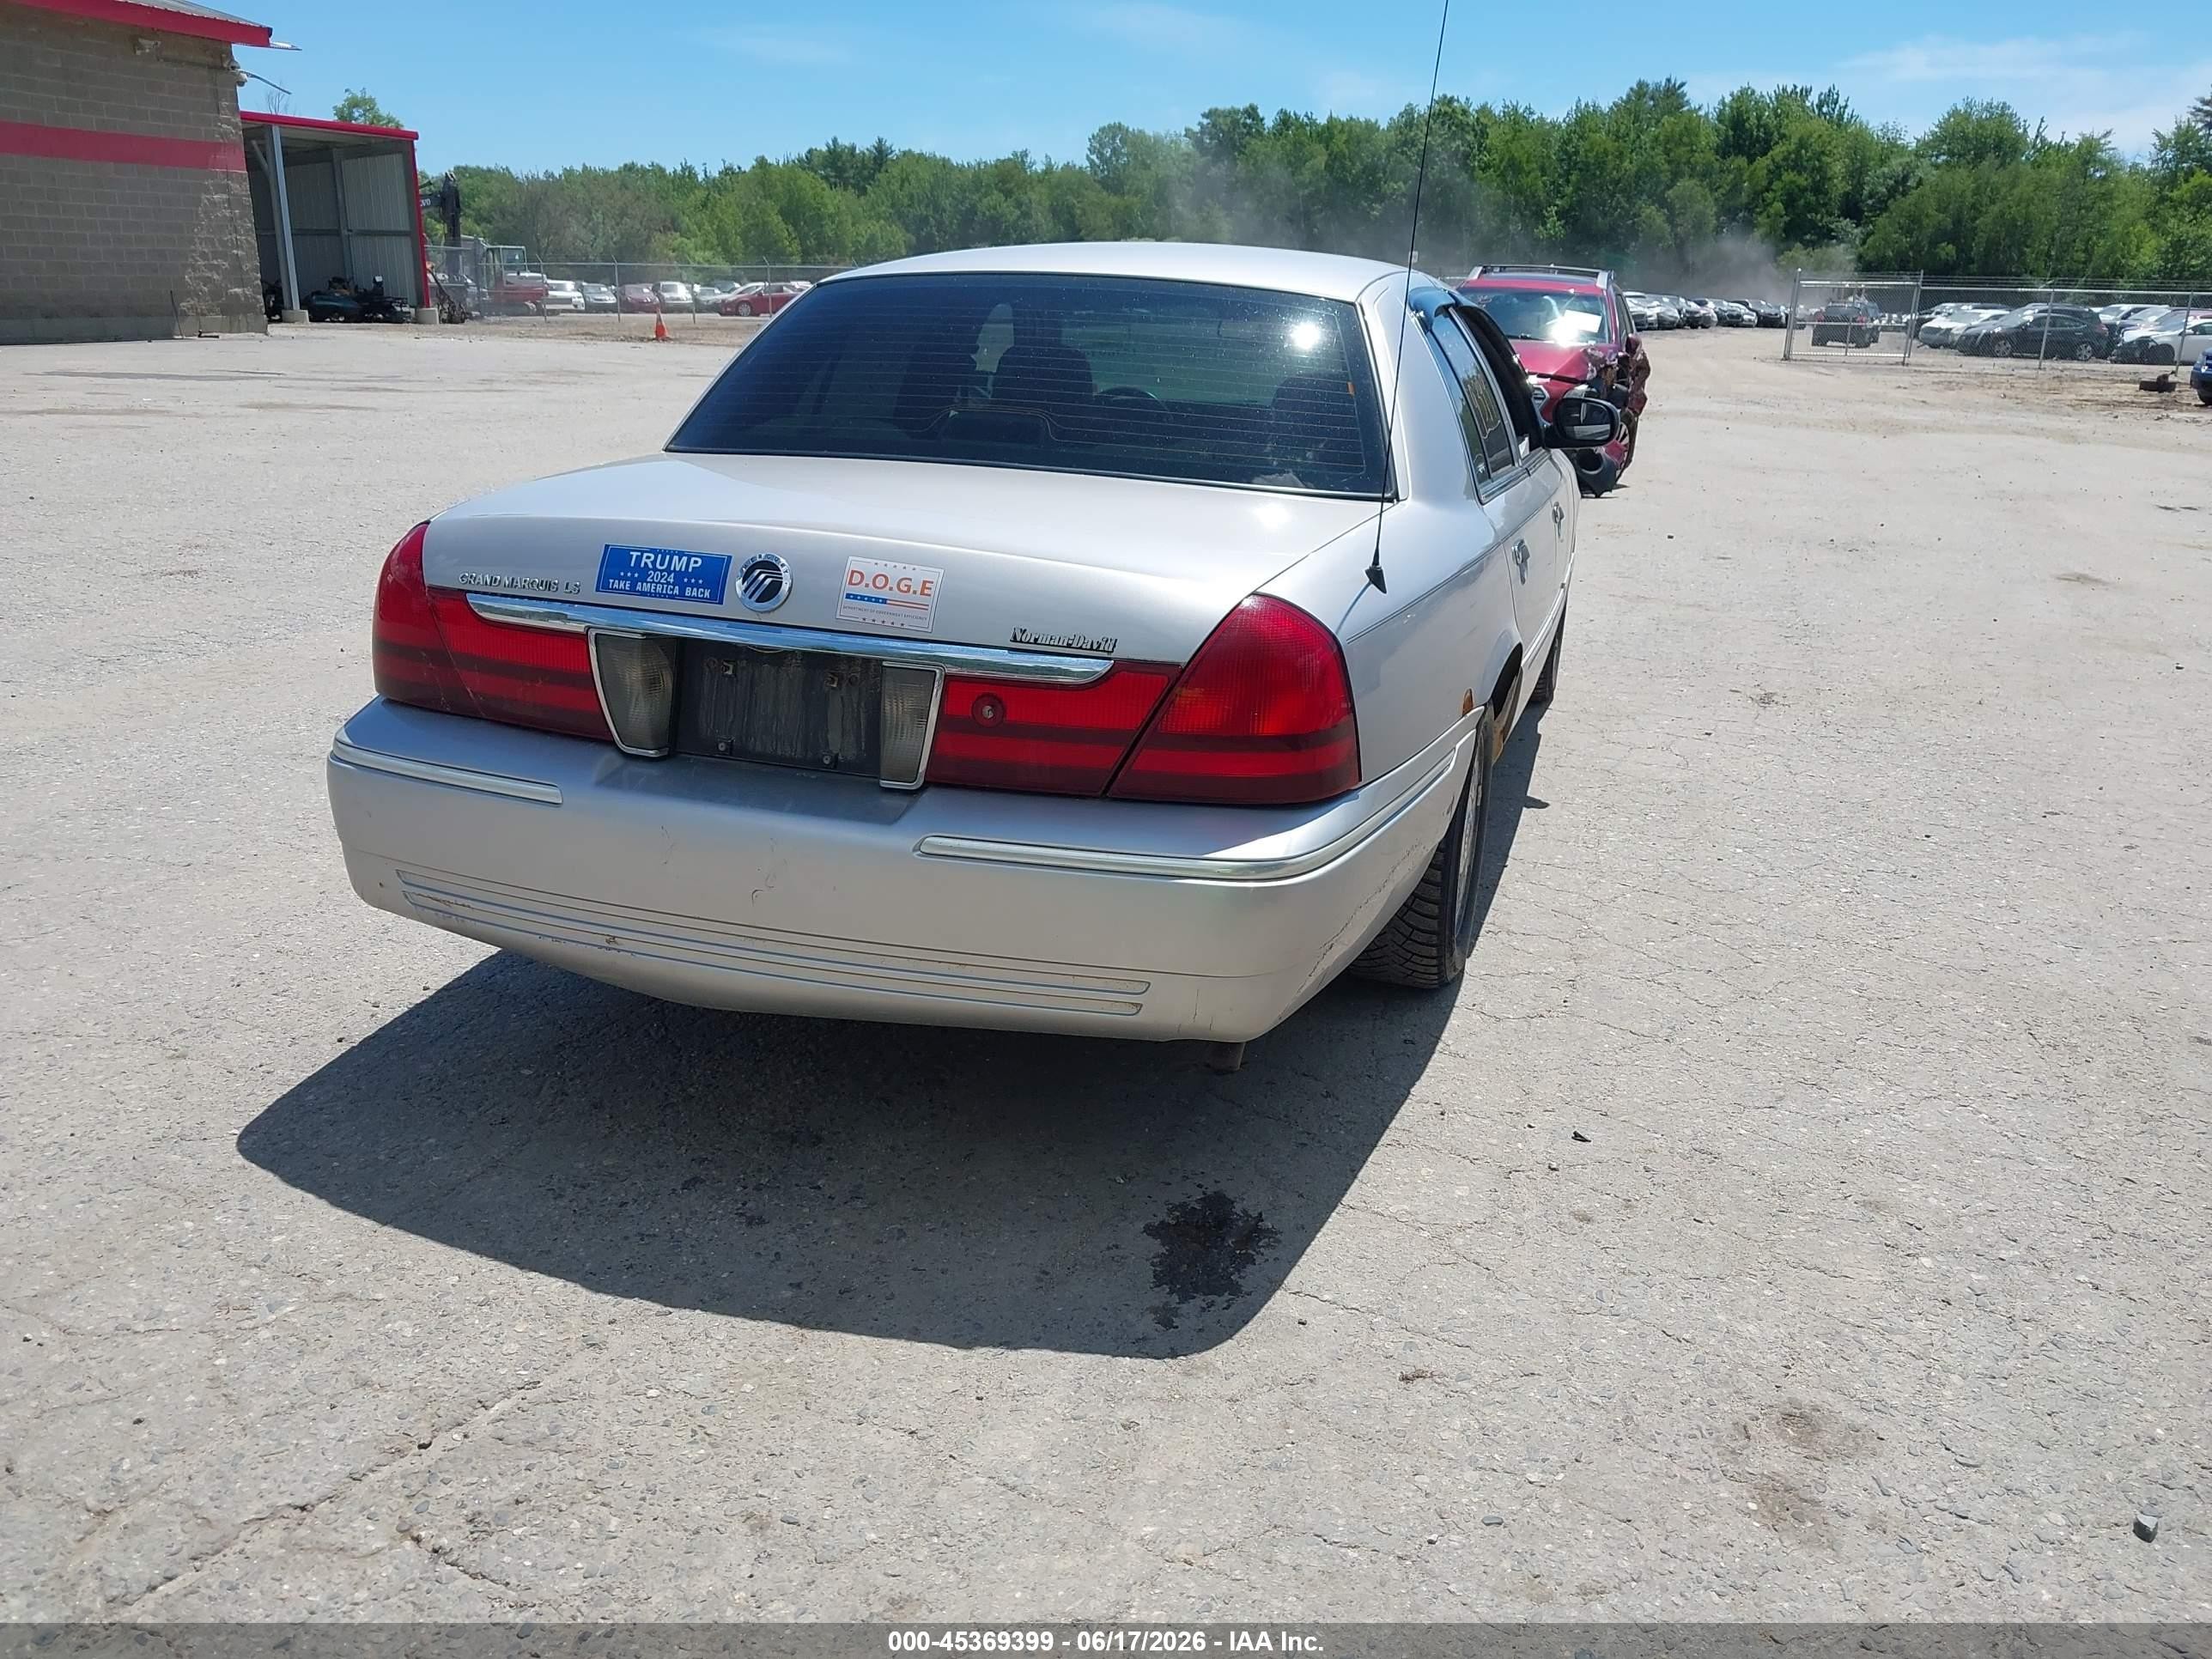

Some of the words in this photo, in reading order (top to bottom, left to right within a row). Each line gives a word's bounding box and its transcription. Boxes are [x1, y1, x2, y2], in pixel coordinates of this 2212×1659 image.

[629, 551, 702, 573] TRUMP
[459, 572, 501, 587] GRAND
[503, 575, 559, 592] MARQUIS
[563, 581, 581, 594] LS
[647, 570, 675, 584] 2024
[848, 569, 934, 597] D.O.G.E
[608, 579, 630, 591] TAKE
[636, 581, 679, 595] AMERICA
[684, 586, 711, 599] BACK
